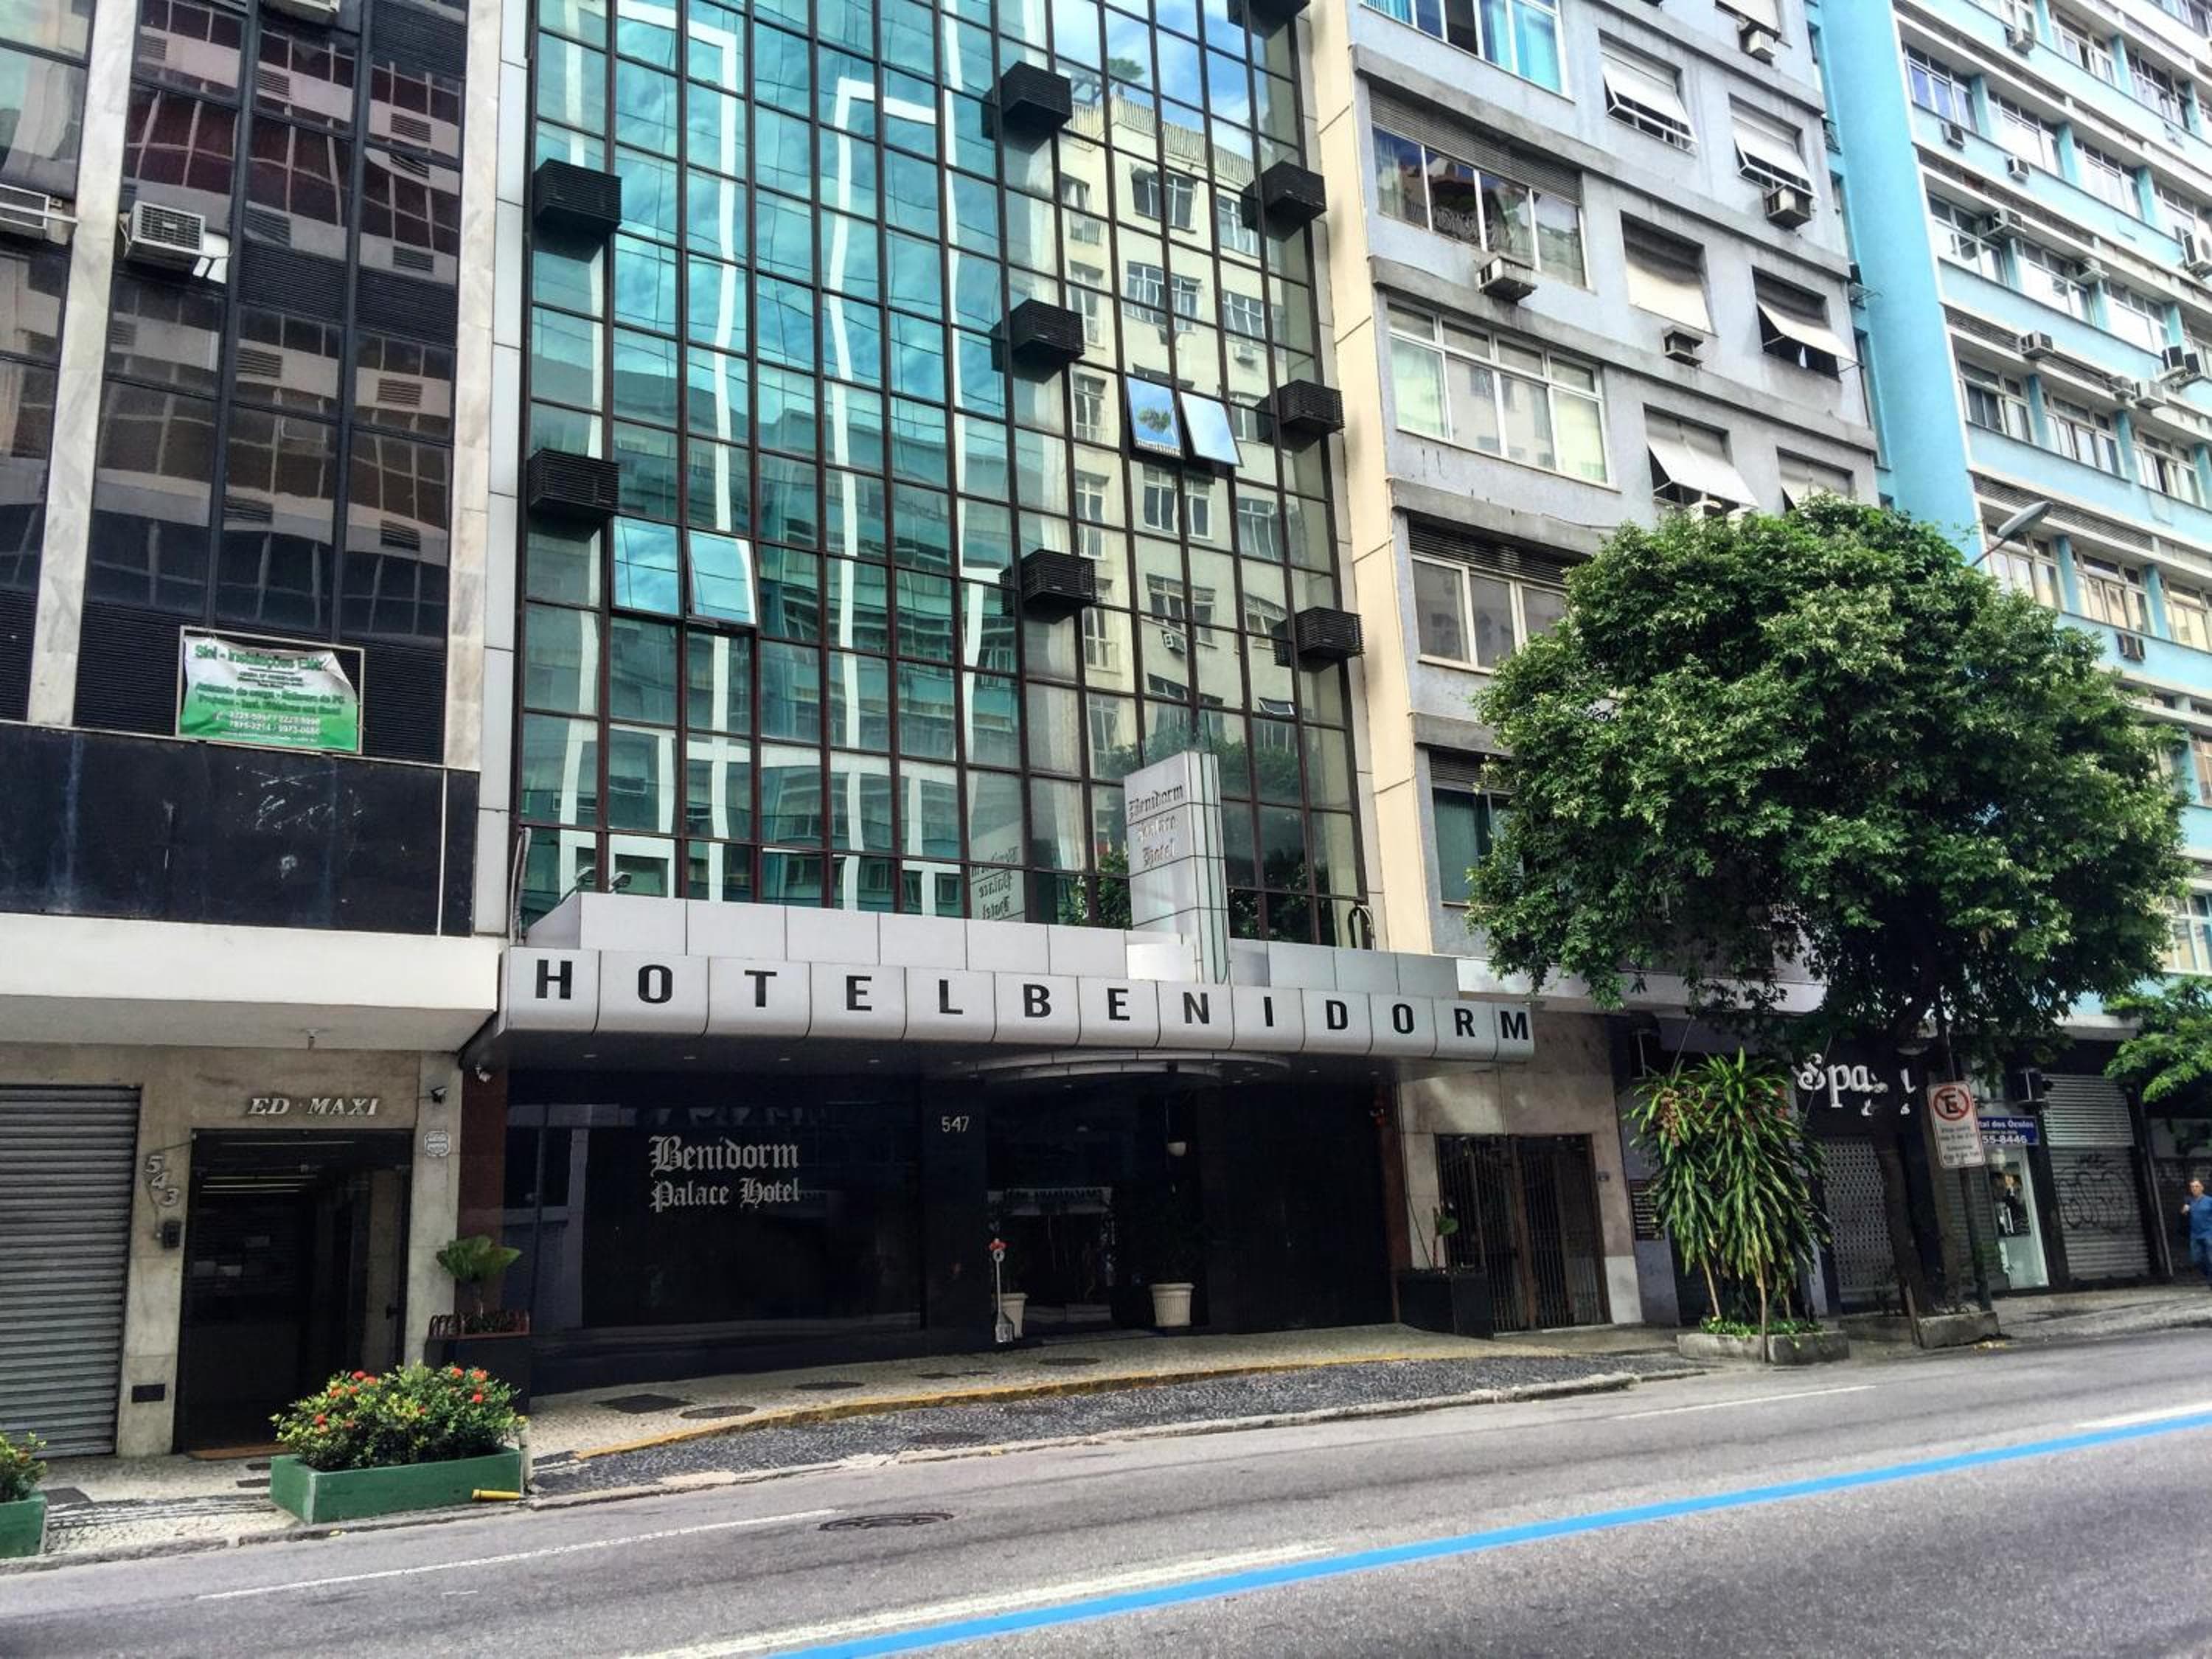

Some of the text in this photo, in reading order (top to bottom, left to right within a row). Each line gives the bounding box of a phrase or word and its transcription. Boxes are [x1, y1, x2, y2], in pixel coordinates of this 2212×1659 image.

[248, 1098, 378, 1115] ED MAXI
[942, 1116, 970, 1133] 547
[649, 1135, 799, 1177] Benidorm
[649, 1177, 800, 1213] Palace Hotel
